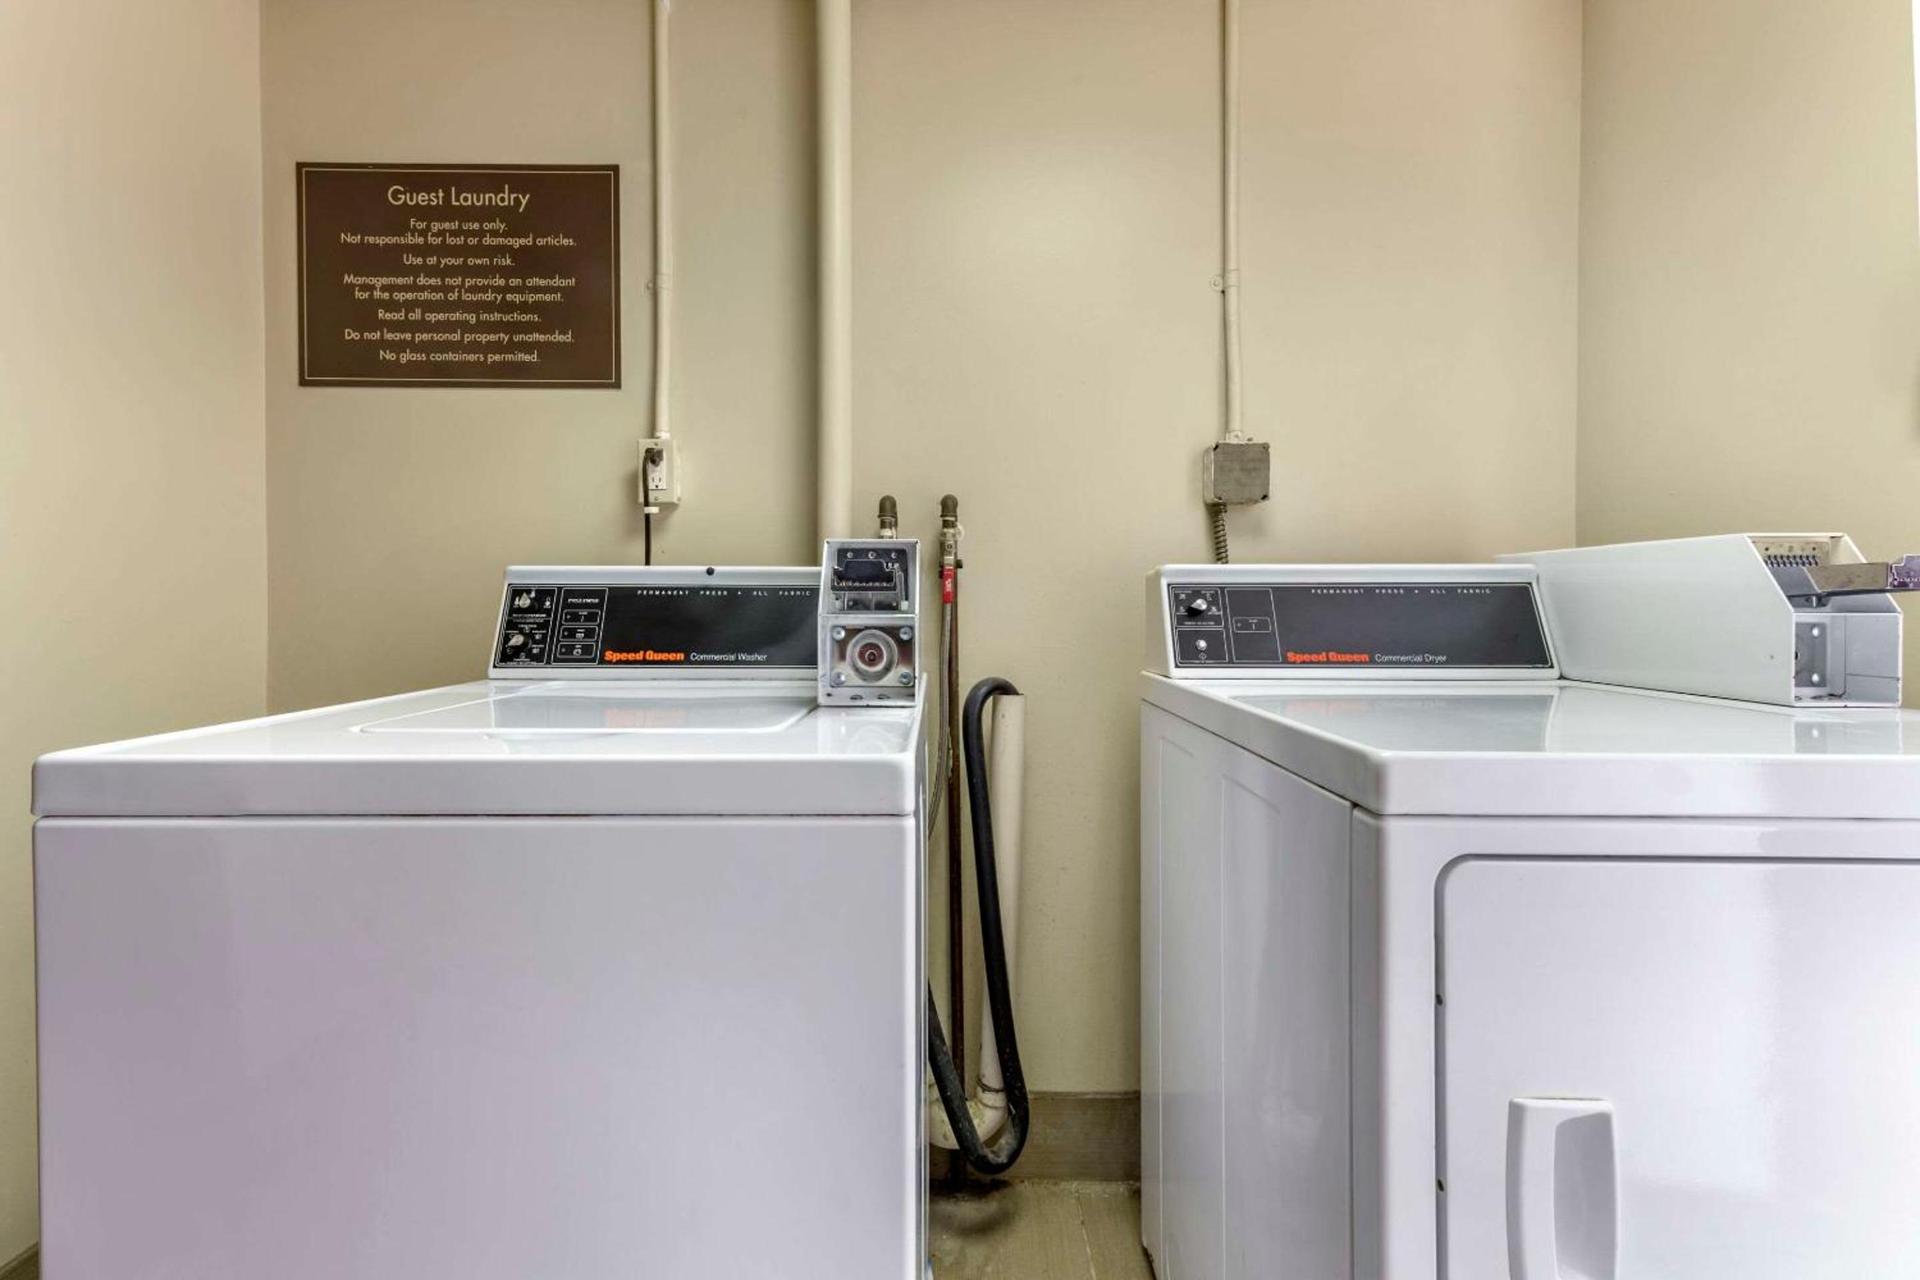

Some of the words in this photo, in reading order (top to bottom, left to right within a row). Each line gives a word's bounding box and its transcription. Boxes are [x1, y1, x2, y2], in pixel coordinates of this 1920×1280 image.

[388, 186, 444, 206] Guest
[452, 183, 530, 212] Laundry
[411, 219, 427, 230] For
[431, 220, 458, 233] guest
[462, 222, 479, 230] use
[483, 218, 507, 233] only.
[341, 233, 360, 244] Not
[364, 232, 424, 246] responsible
[428, 233, 442, 244] for
[446, 233, 464, 245] lost
[482, 233, 532, 248] damaged
[536, 234, 576, 247] articles.
[403, 254, 423, 264] Use
[426, 256, 437, 264] at
[440, 258, 463, 268] your
[494, 254, 515, 265] risk.
[344, 273, 413, 288] Management
[417, 273, 441, 286] does
[445, 275, 462, 286] not
[465, 274, 505, 289] provide
[526, 275, 575, 286] attendant
[355, 287, 370, 299] for
[373, 287, 389, 299] the
[393, 289, 444, 303] operation
[448, 288, 459, 300] of
[462, 289, 502, 303] laundry
[506, 291, 563, 304] equipment.
[378, 308, 405, 320] Read
[408, 308, 421, 321] all
[425, 311, 476, 324] operating
[480, 310, 541, 322] instructions.
[345, 329, 360, 340] Do
[364, 330, 380, 340] not
[384, 328, 412, 340] leave
[415, 328, 460, 344] personal
[464, 332, 509, 345] property
[513, 329, 574, 342] unattended.
[380, 350, 396, 360] No
[399, 349, 426, 365] glass
[430, 351, 484, 361] containers
[487, 350, 540, 365] permitted.
[604, 650, 644, 662] Speed
[645, 651, 685, 661] Queen
[690, 651, 736, 662] Commercial
[738, 652, 769, 662] Washer
[1287, 651, 1327, 662] Speed
[1328, 651, 1370, 662] Queen
[1375, 653, 1423, 662] Commercial
[1424, 653, 1448, 663] Dryer
